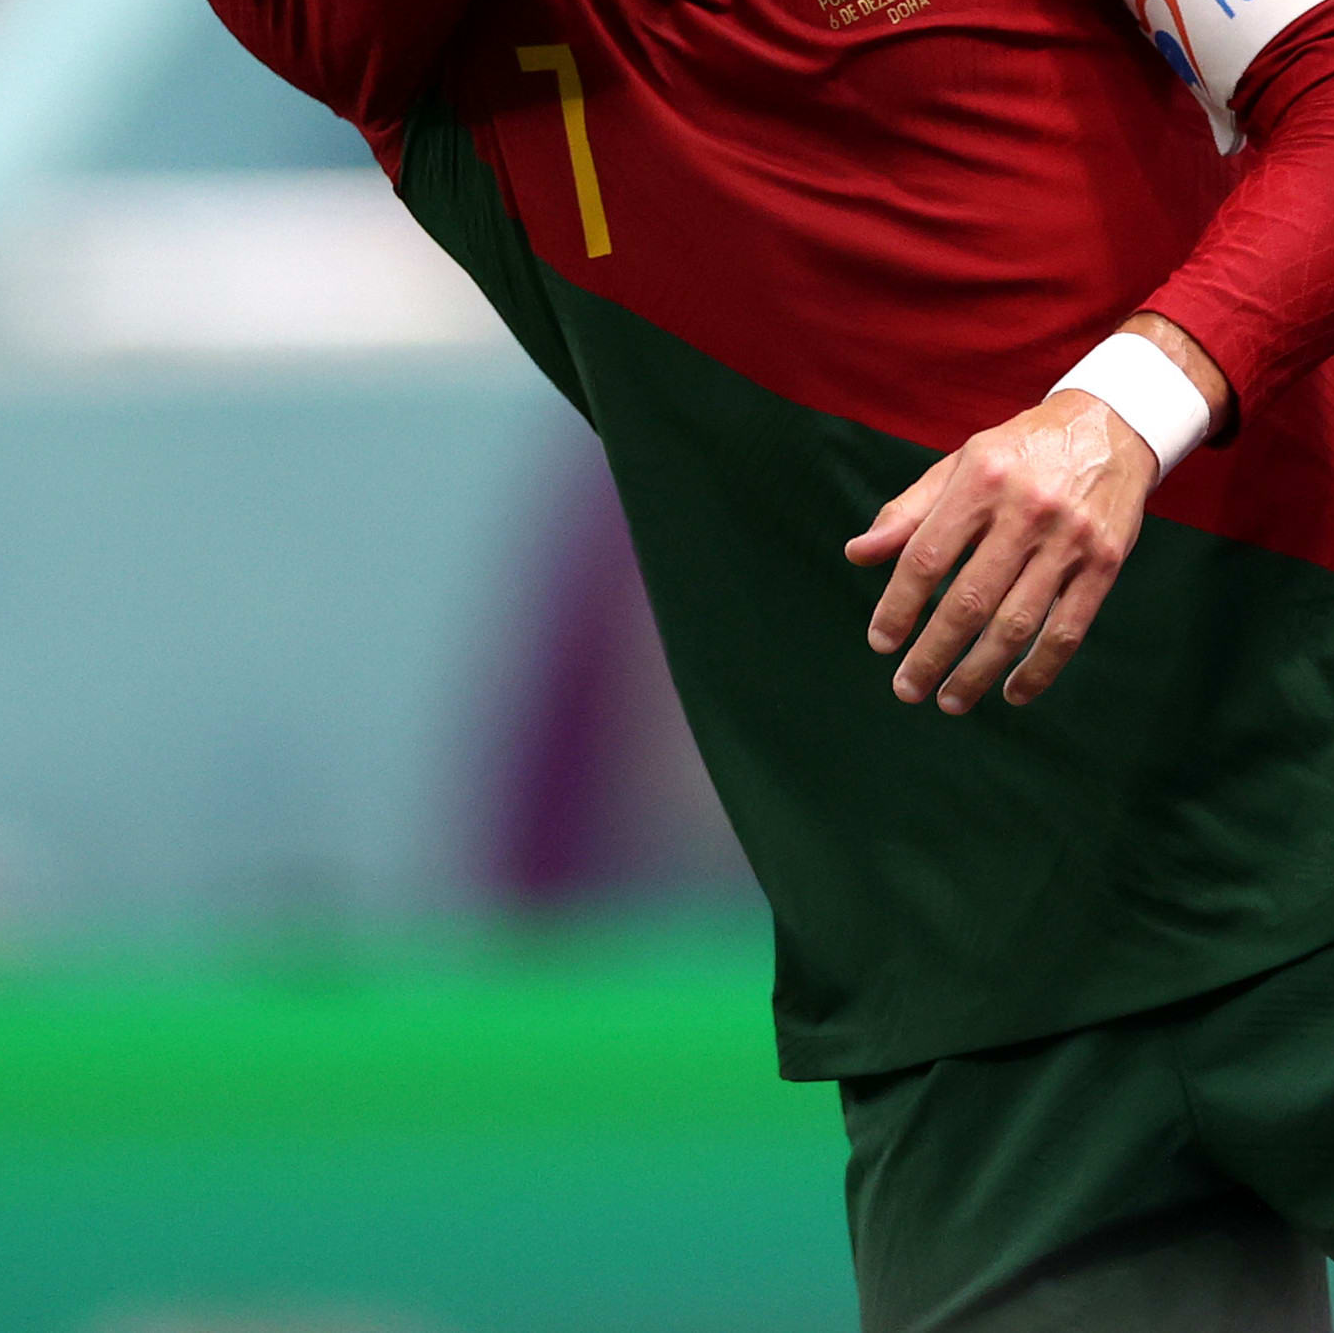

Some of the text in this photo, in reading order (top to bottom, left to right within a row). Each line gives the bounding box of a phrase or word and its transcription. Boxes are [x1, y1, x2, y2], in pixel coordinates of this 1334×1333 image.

[829, 12, 840, 30] 6
[839, 3, 860, 25] DE
[516, 43, 612, 259] 7
